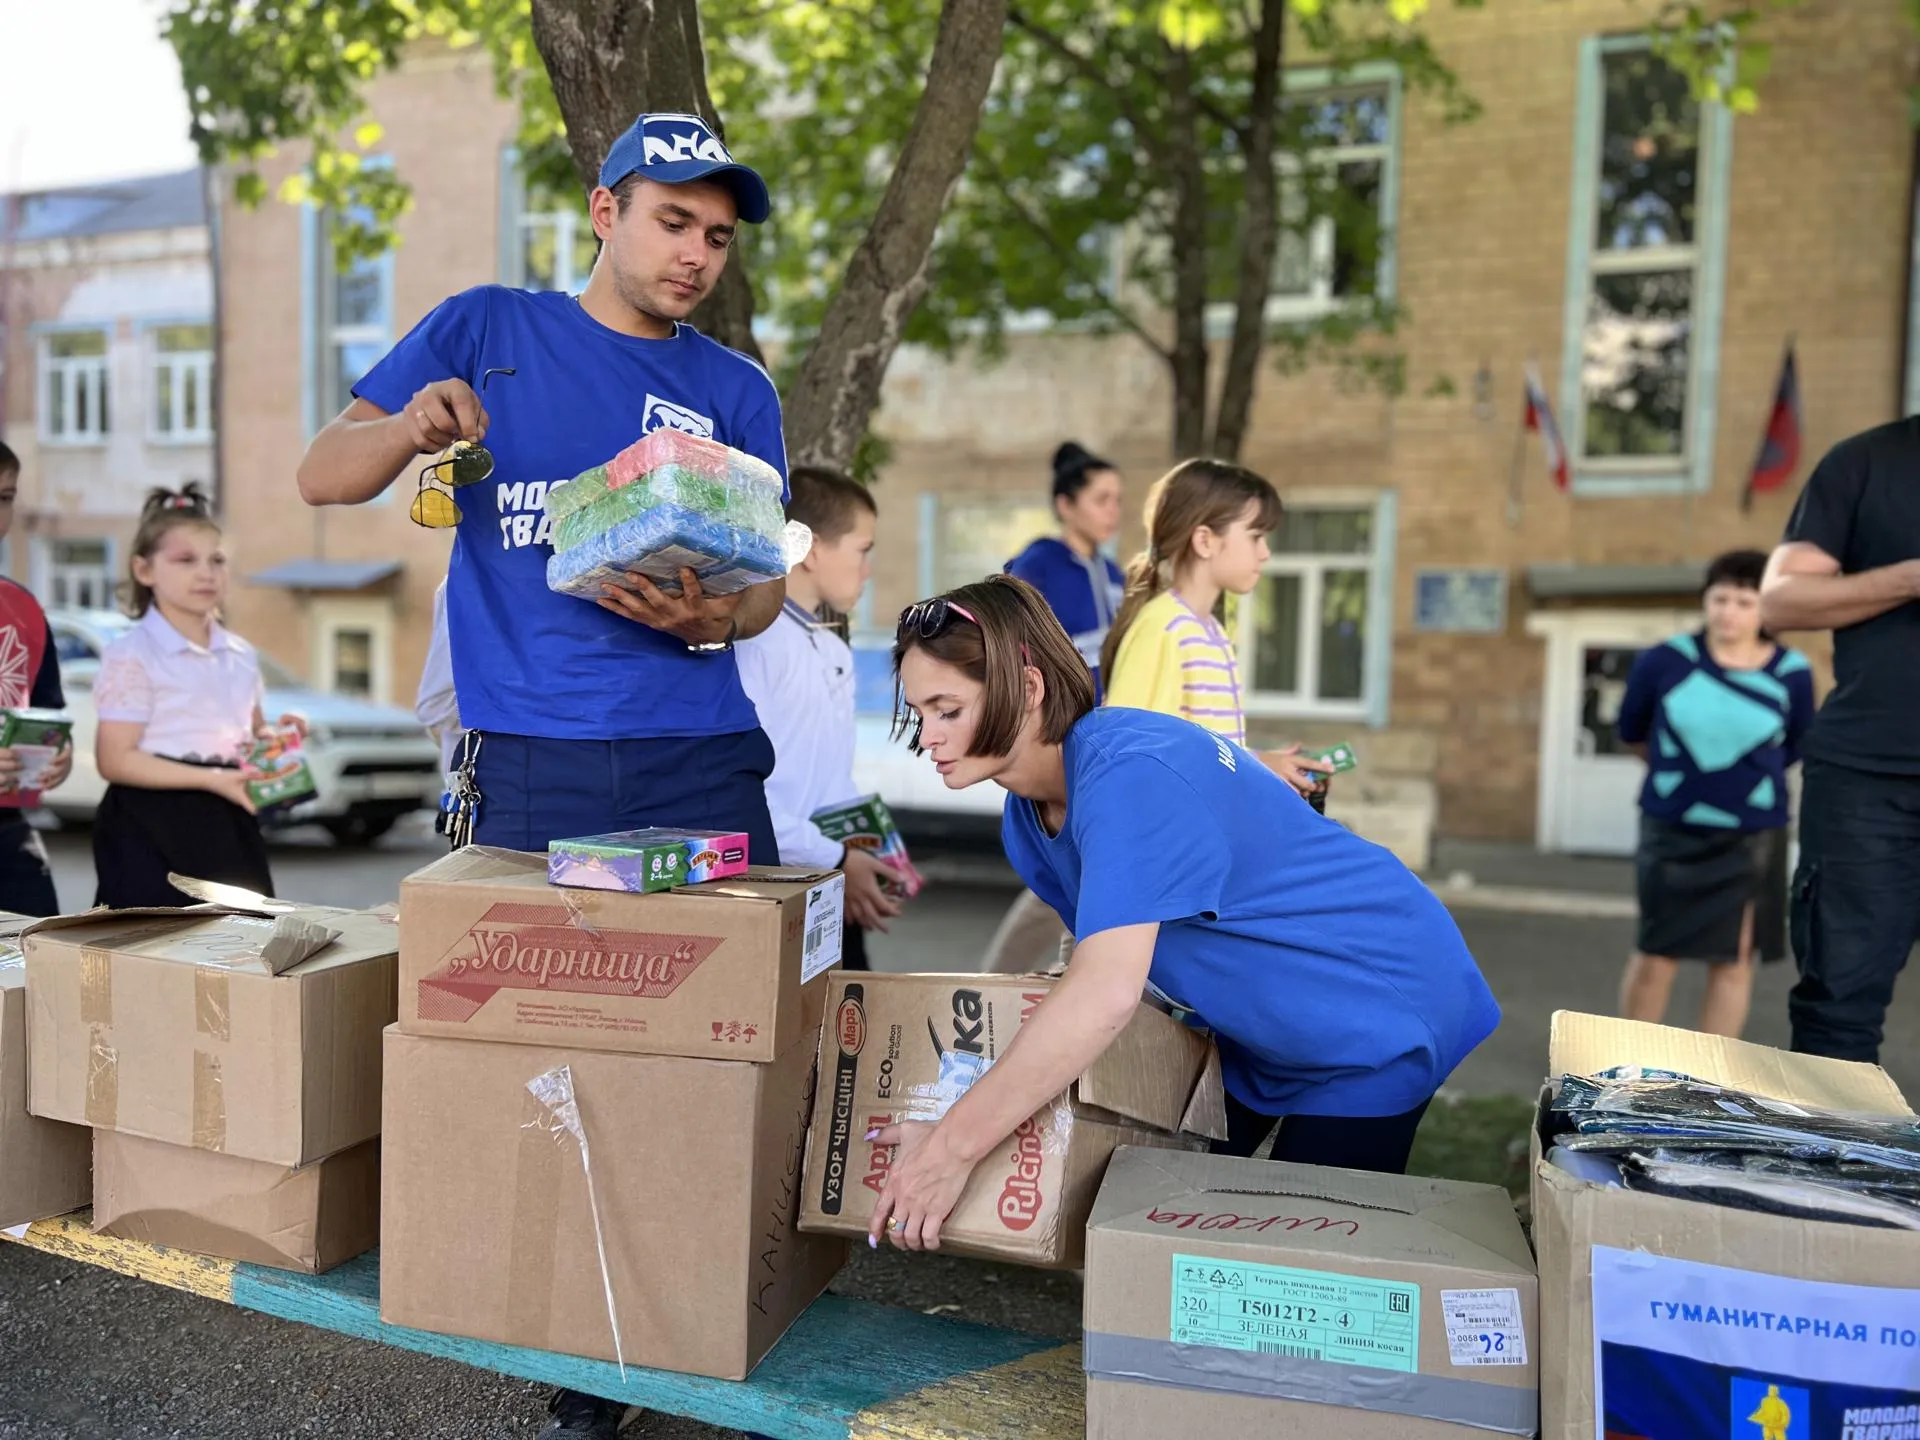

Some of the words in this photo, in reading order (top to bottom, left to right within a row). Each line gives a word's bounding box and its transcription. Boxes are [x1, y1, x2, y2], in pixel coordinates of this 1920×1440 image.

[498, 480, 569, 513] МО
[888, 1024, 897, 1059] solution
[826, 1151, 843, 1202] УЗОР
[1283, 1288, 1306, 1297] ГОСТ
[1291, 1280, 1335, 1293] школьная
[1338, 1286, 1348, 1295] 12
[1350, 1289, 1379, 1298] листов
[1180, 1296, 1207, 1312] 320
[1188, 1318, 1198, 1326] 10
[1238, 1320, 1308, 1340] ЗЕЛЕНАЯ
[1650, 1300, 1868, 1343] ГУМАНИТАРНАЯ
[1880, 1326, 1920, 1348] ПО
[1334, 1335, 1374, 1348] ЛИНИЯ
[1377, 1342, 1405, 1353] косая
[1843, 1405, 1920, 1425] МОЛОДА
